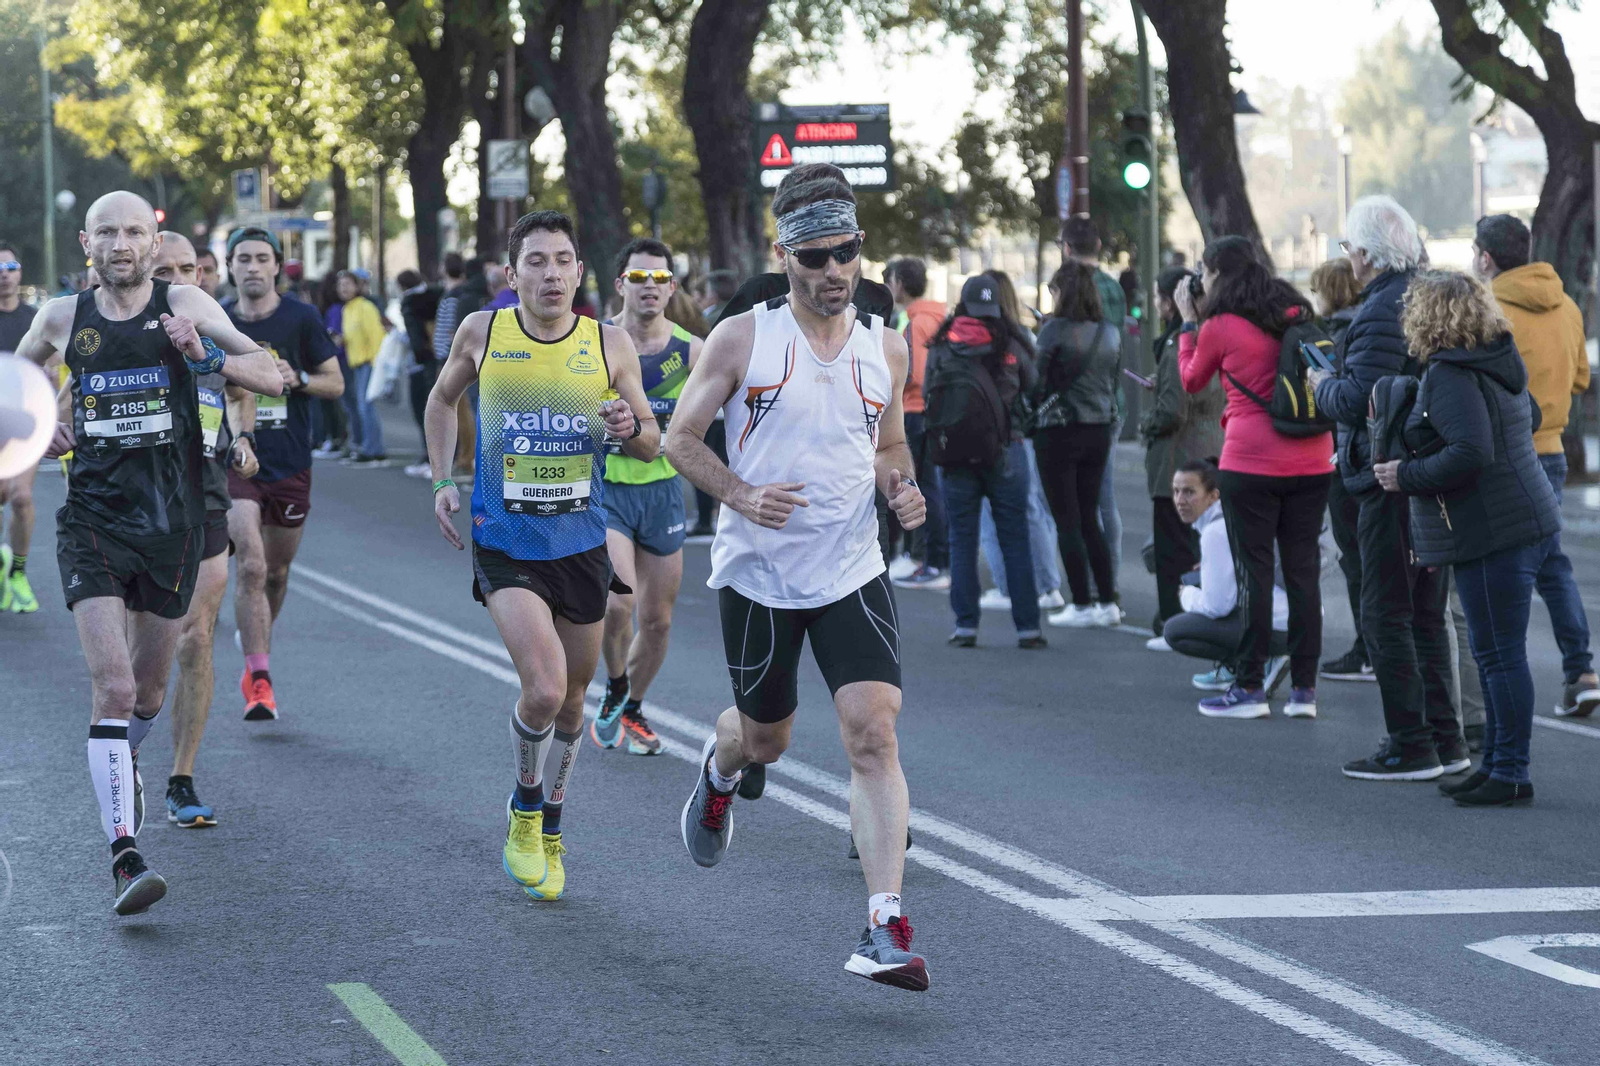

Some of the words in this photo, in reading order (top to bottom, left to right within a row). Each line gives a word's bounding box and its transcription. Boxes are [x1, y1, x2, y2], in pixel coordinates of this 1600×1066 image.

[109, 373, 159, 387] ZURICH
[111, 401, 146, 416] 2185
[116, 421, 142, 432] MATT
[501, 407, 588, 434] xaloc
[533, 441, 582, 452] ZURICH
[532, 467, 565, 479] 1233
[522, 487, 573, 498] GUERRERO
